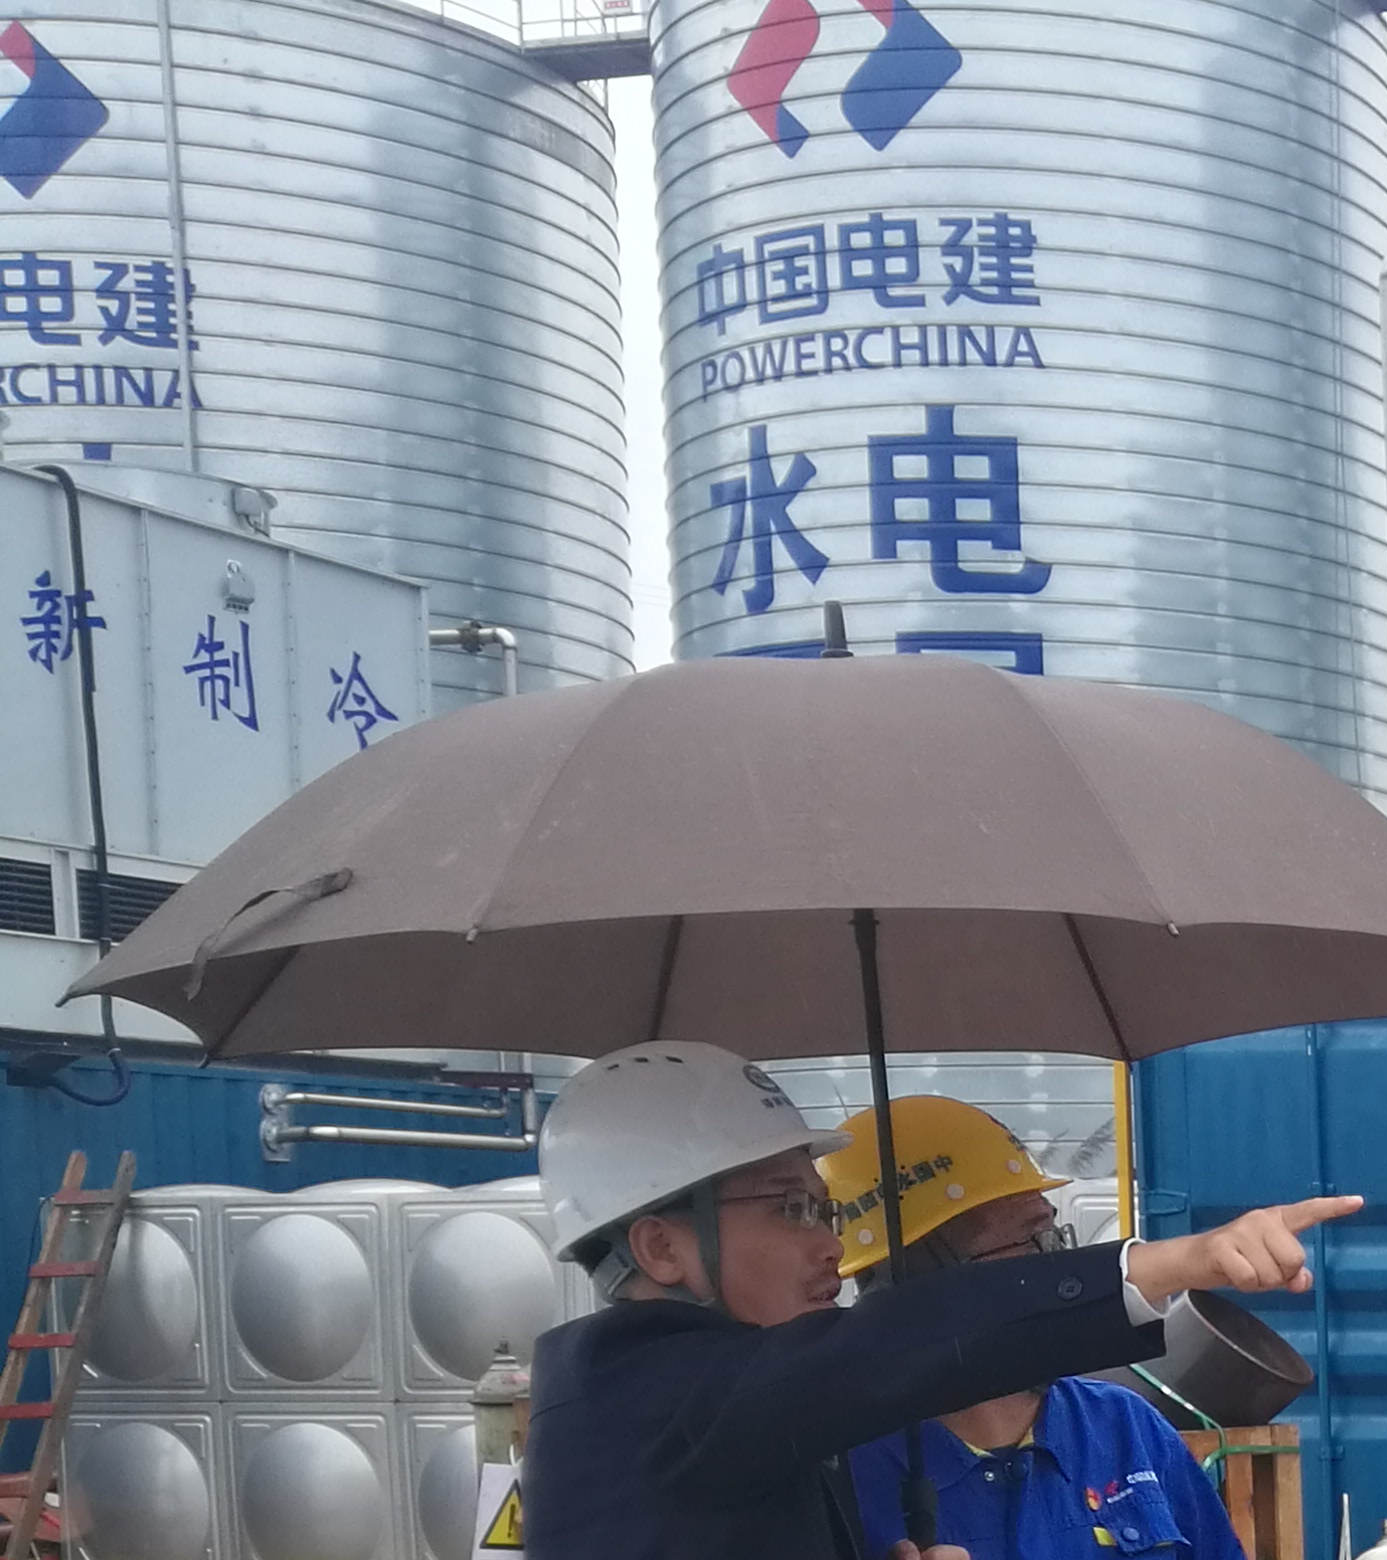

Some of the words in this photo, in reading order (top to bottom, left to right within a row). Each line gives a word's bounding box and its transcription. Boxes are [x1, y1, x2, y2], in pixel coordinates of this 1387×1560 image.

[697, 212, 1041, 336] 中国电建
[0, 363, 203, 408] CHINA
[701, 325, 1046, 402] POWERCHINA
[710, 404, 1052, 616] 水电
